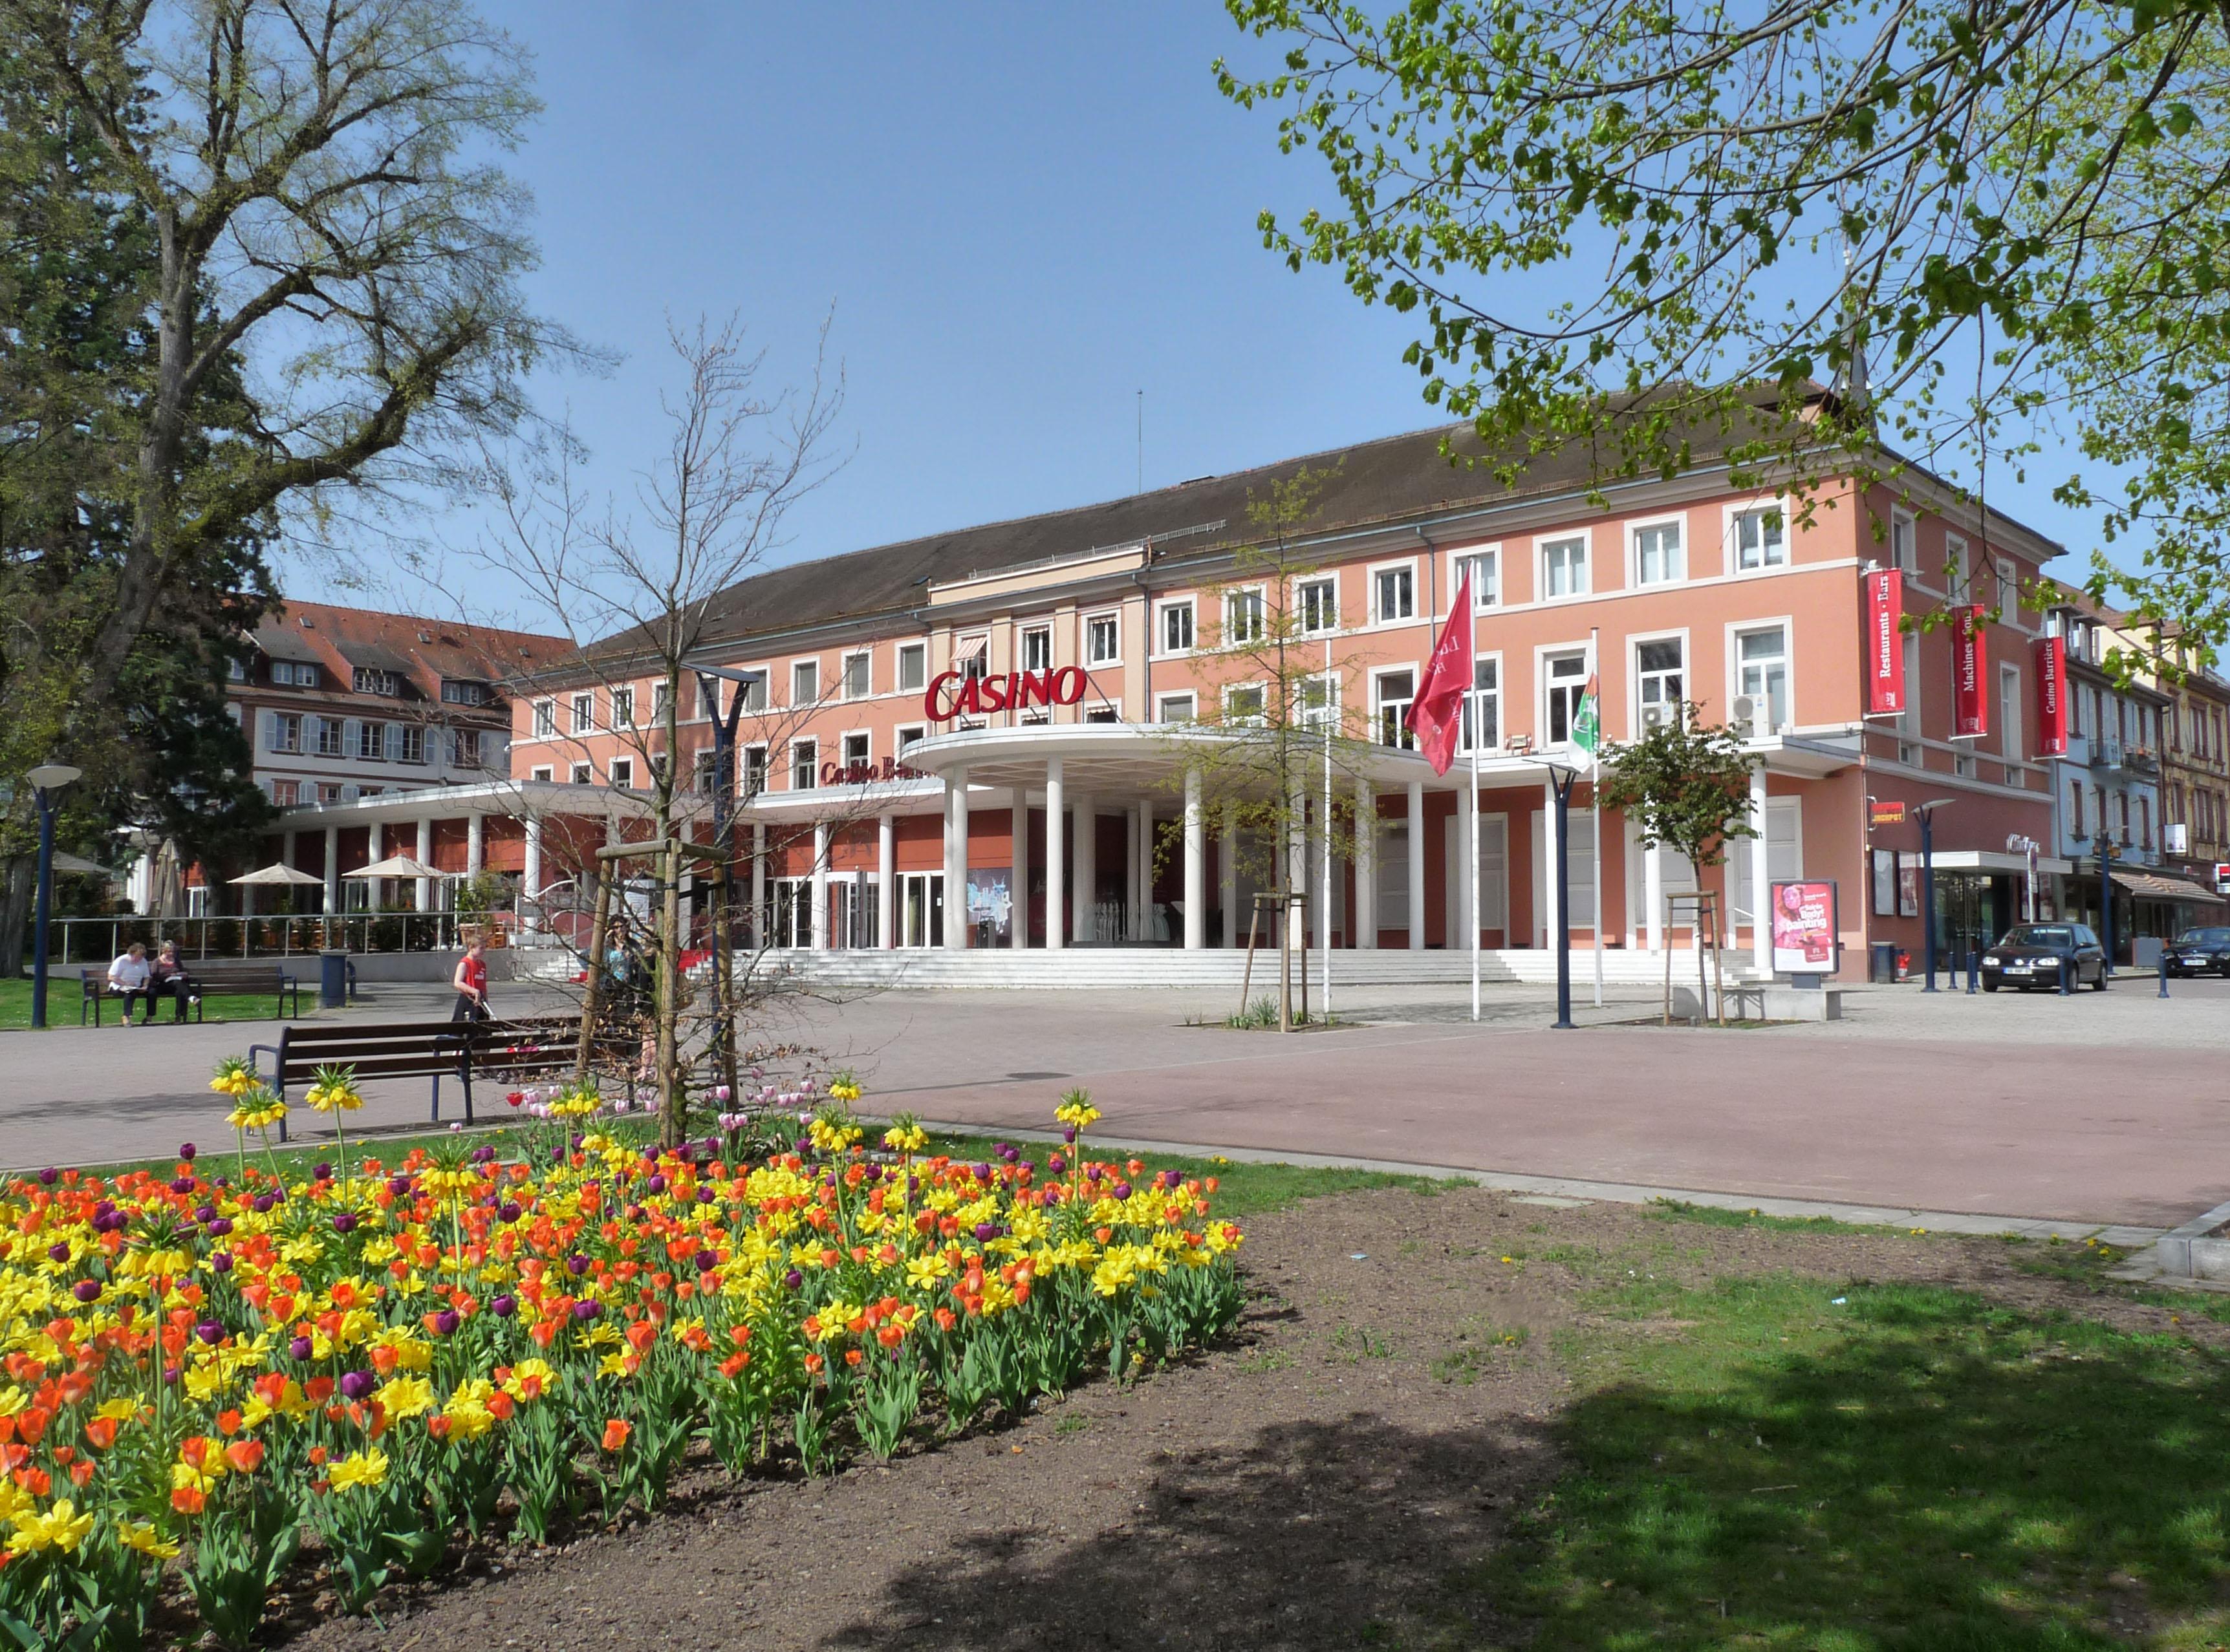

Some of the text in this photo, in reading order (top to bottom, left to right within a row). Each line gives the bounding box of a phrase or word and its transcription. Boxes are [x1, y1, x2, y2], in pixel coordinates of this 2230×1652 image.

[1878, 575, 1890, 678] Restaurants Bars
[924, 666, 1087, 722] CASINO
[1962, 643, 1975, 692] Machines
[2044, 642, 2056, 714] Casino Barrière
